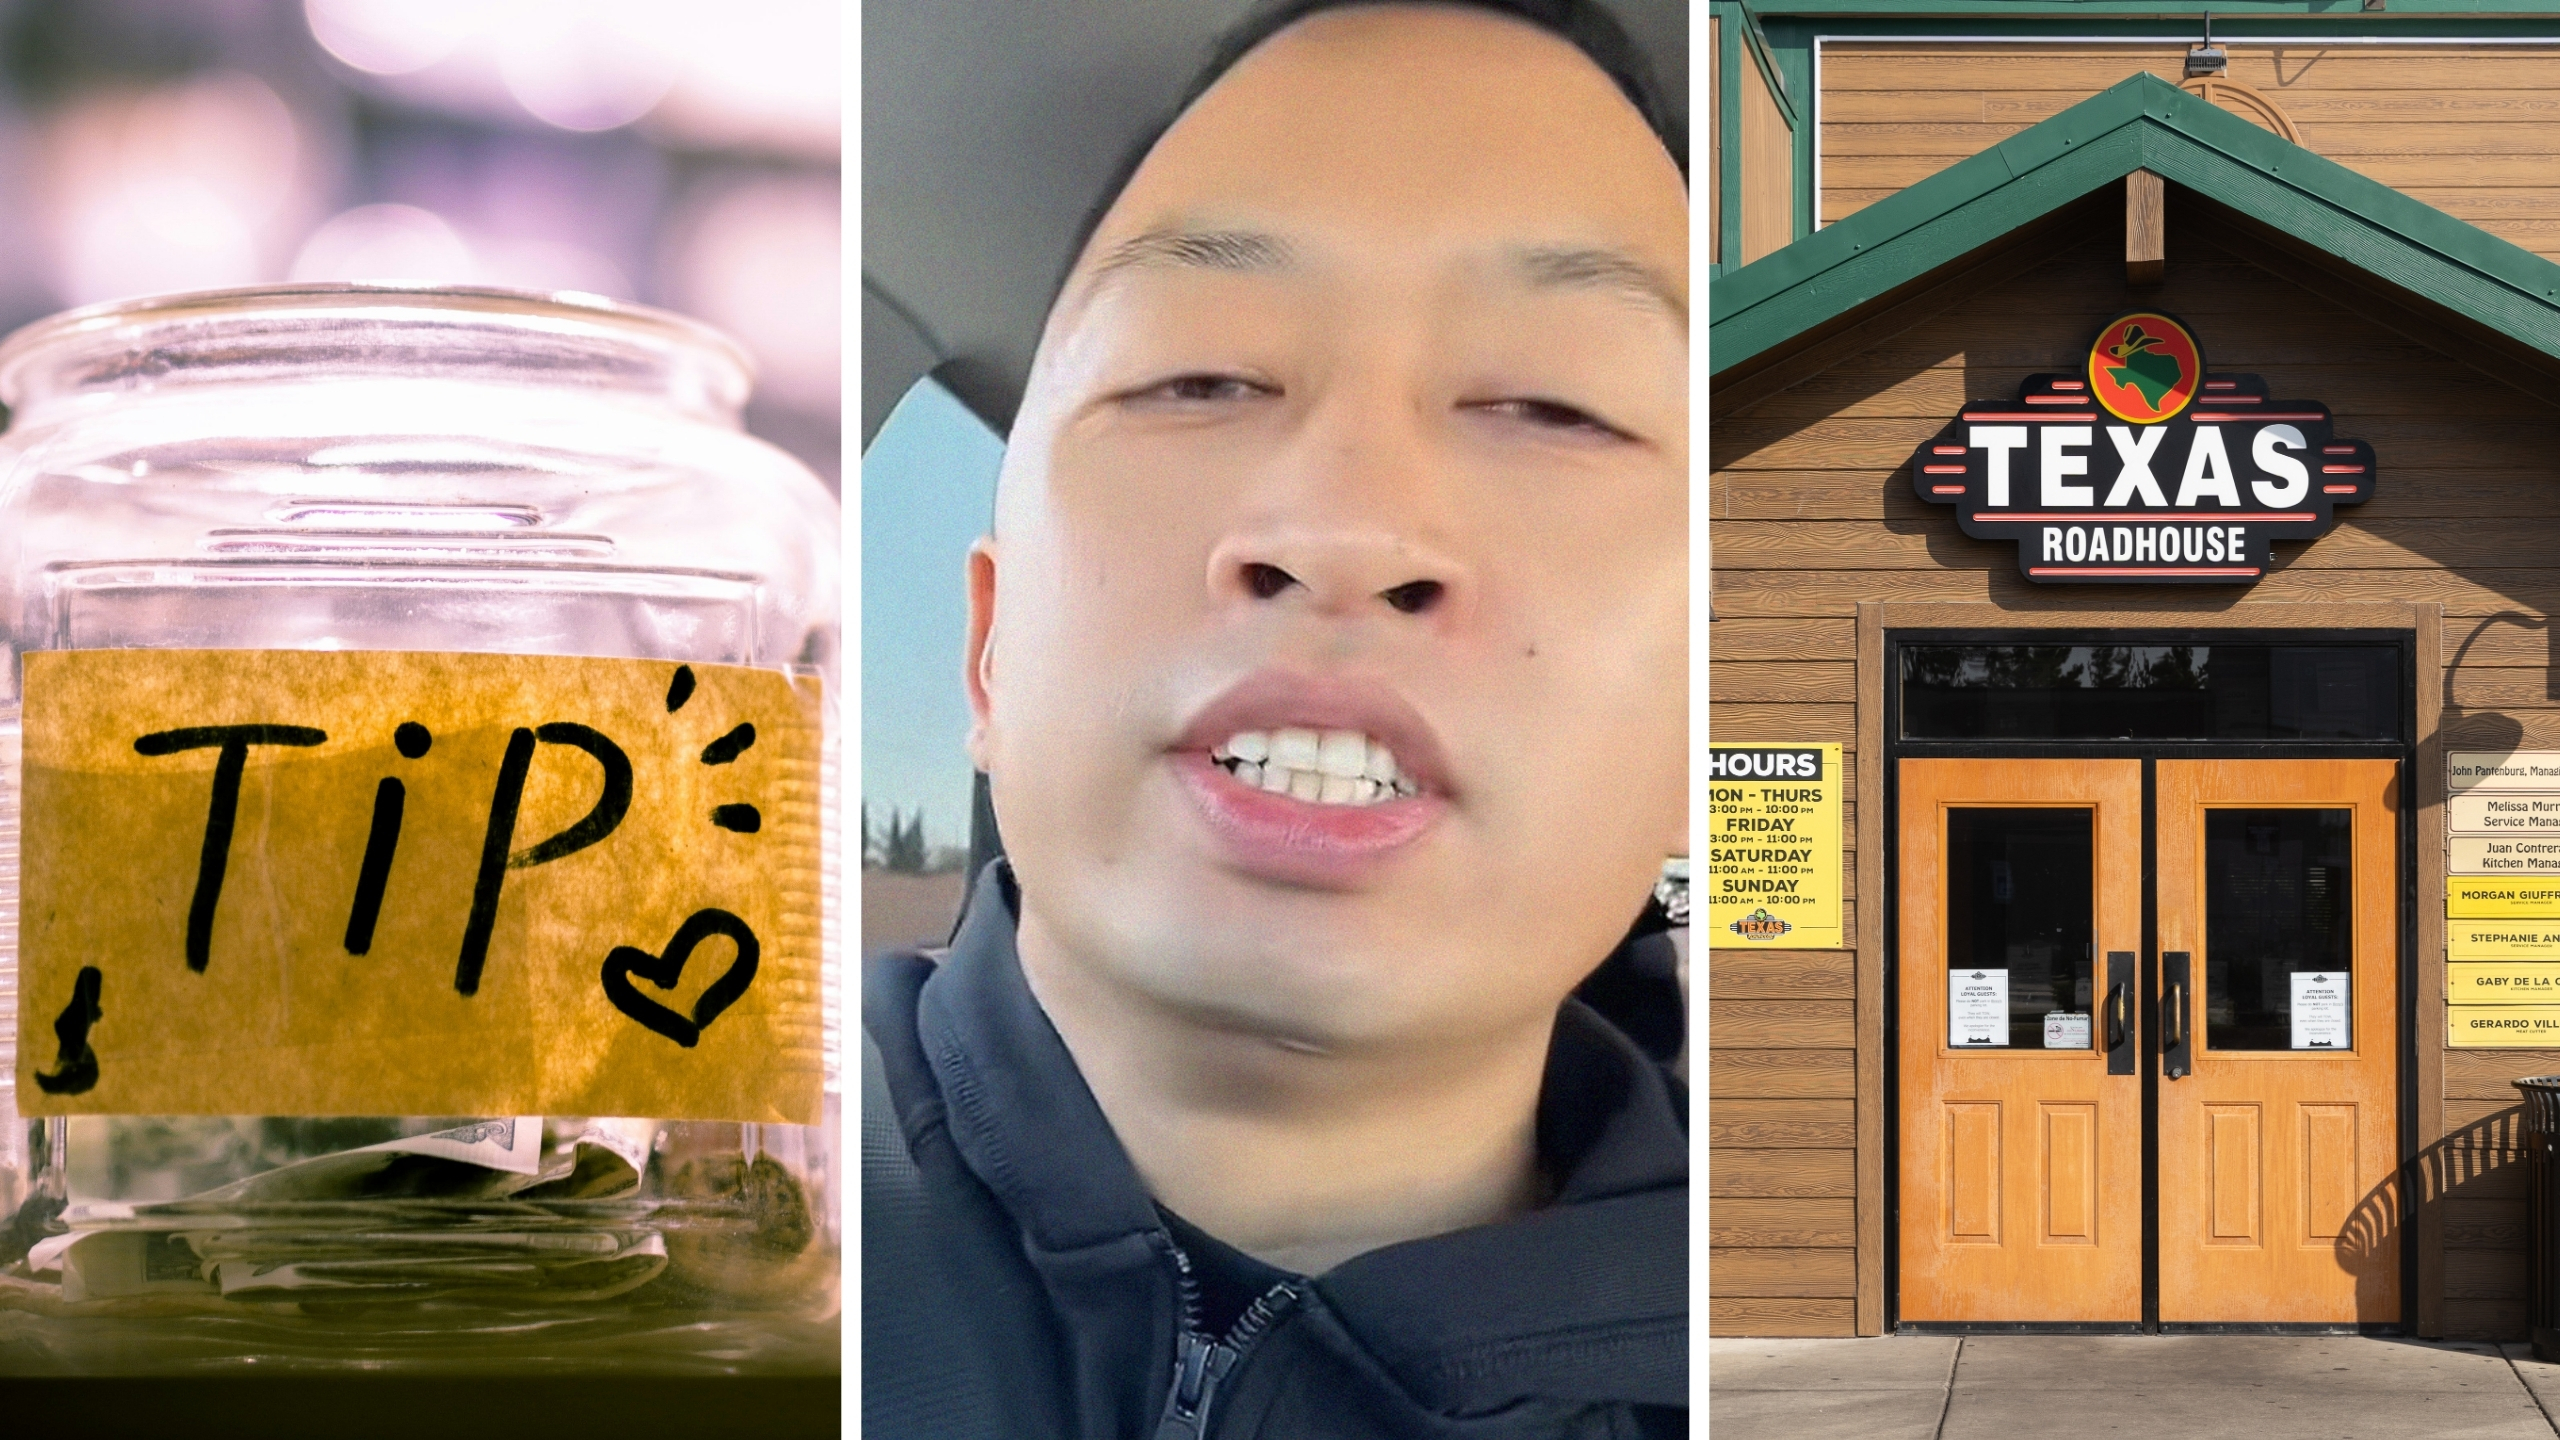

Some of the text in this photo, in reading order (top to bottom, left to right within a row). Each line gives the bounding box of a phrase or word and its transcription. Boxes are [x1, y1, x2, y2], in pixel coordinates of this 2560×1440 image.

[1969, 424, 2310, 509] TEXAS
[2042, 526, 2246, 562] ROADHOUSE
[1709, 753, 1816, 777] HOURS
[2452, 766, 2472, 776] John
[1760, 788, 1823, 802] THURS
[1709, 805, 1737, 814] 3:00
[1766, 805, 1798, 814] 10:00
[2487, 801, 2528, 812] Melissa
[1726, 818, 1795, 832] FRIDAY
[2484, 816, 2525, 827] Service
[1710, 834, 1737, 843] 3:00
[1767, 834, 1797, 843] 11:00
[2486, 842, 2512, 854] Juan
[1710, 849, 1812, 862] SATURDAY
[2482, 857, 2523, 868] Kitchen
[1709, 865, 1739, 874] 11:00
[1767, 865, 1798, 874] 11:00
[1722, 879, 1799, 893] SUNDAY
[1709, 895, 1738, 904] 11:00
[1767, 895, 1800, 904] 10:00
[2461, 890, 2560, 900] MORGAN GIUFFR
[1739, 921, 1783, 933] TEXAS
[2470, 933, 2538, 943] STEPHANIE
[2476, 977, 2509, 986] GABY
[2514, 977, 2530, 986] DE
[2534, 977, 2551, 986] LA
[2470, 1019, 2560, 1029] GERARDO VILL
